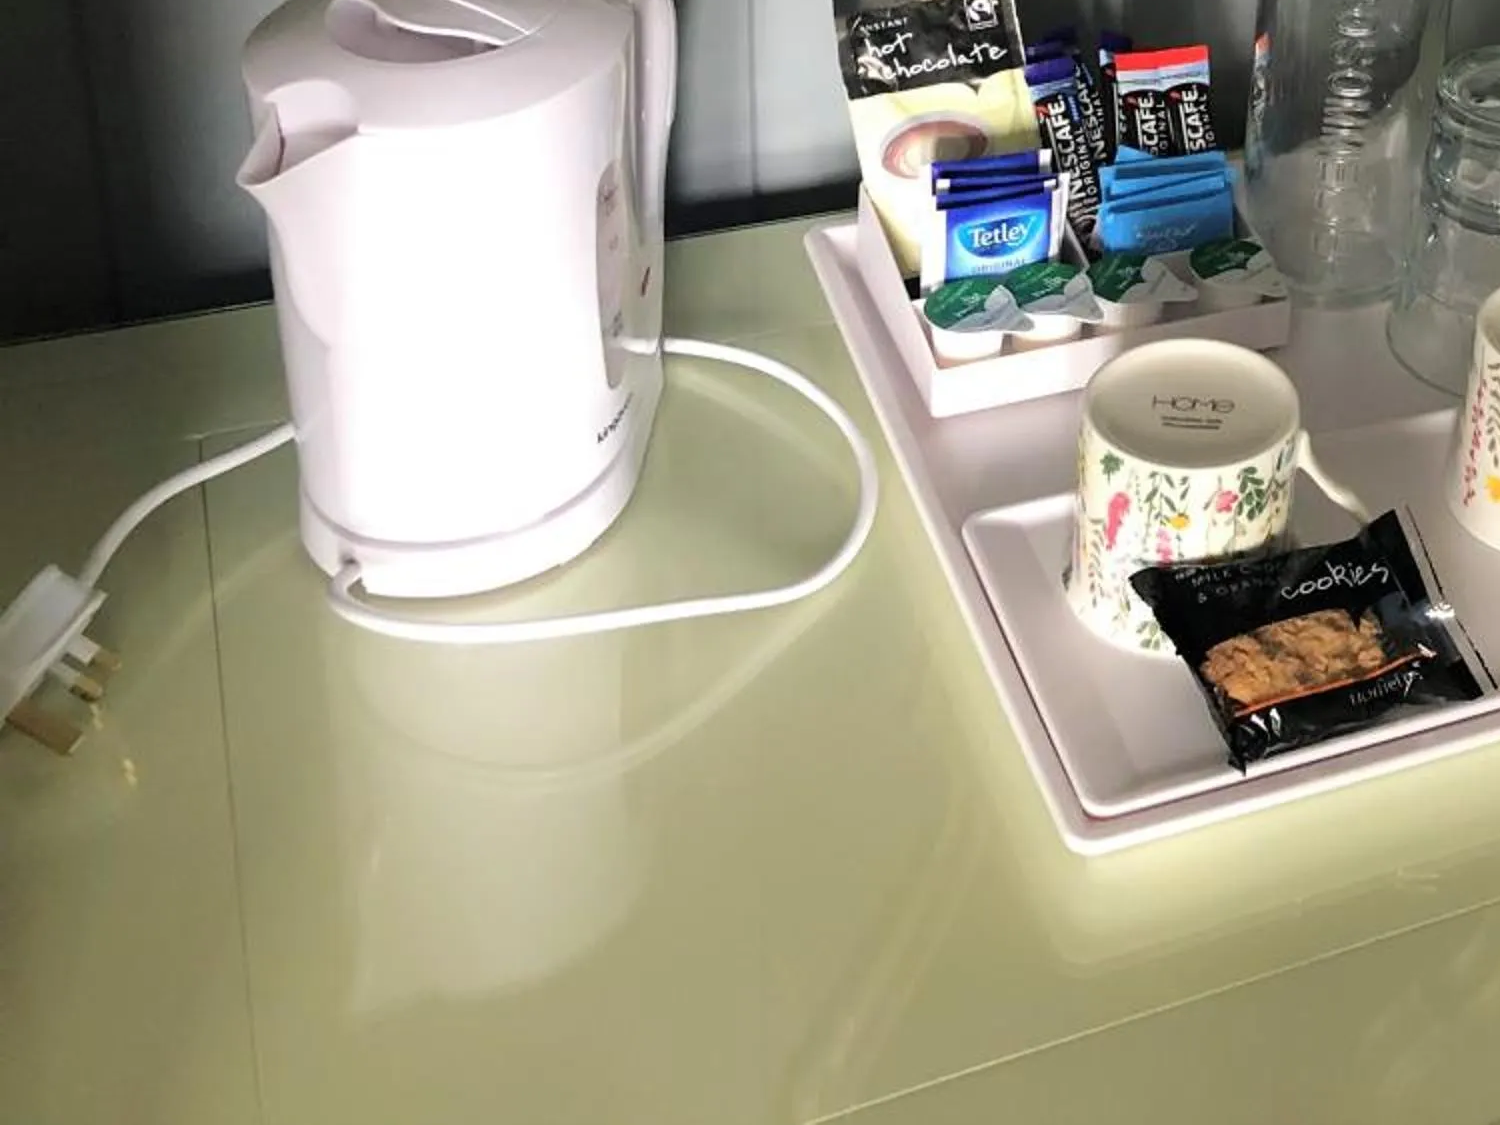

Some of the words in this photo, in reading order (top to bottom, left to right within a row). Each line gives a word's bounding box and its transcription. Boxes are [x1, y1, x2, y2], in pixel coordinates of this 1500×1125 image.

[864, 32, 912, 58] hot
[1074, 126, 1098, 196] ORIGINAL
[968, 216, 1036, 247] Tetley
[1281, 559, 1389, 600] cookies
